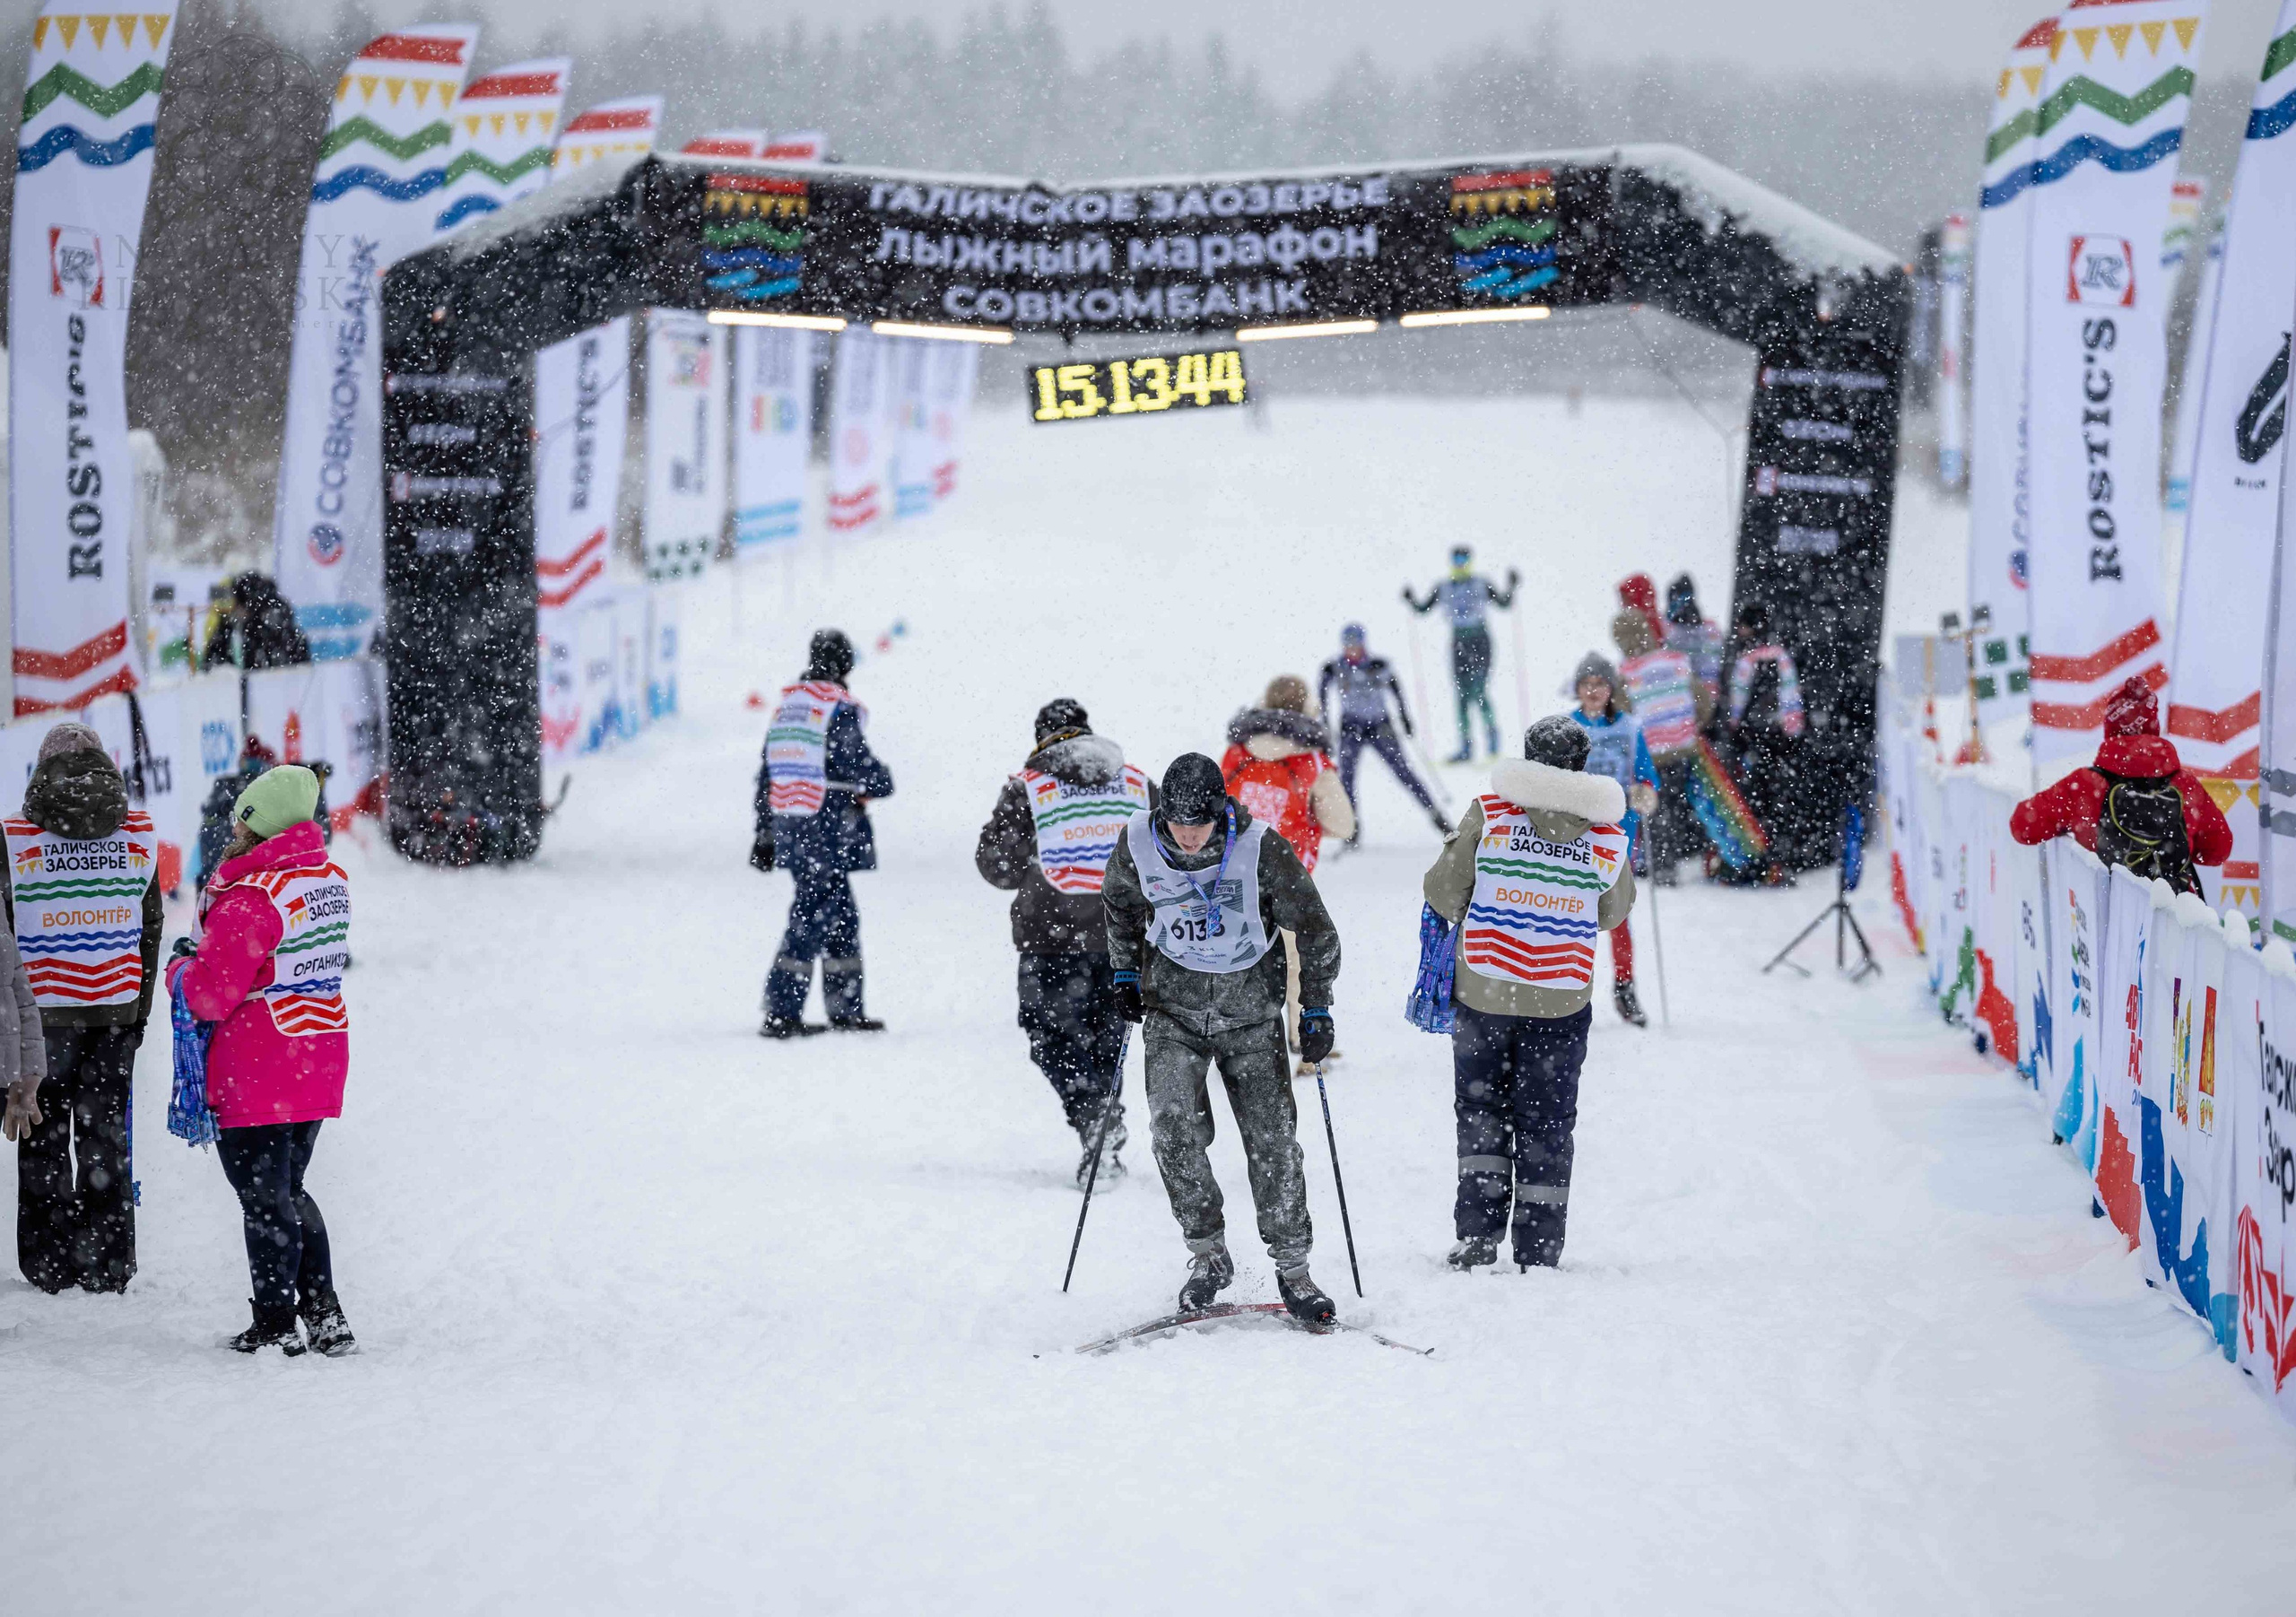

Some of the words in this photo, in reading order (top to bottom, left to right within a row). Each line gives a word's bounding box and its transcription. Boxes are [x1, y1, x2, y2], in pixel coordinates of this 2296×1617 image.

[868, 183, 1138, 224] ГАЛИЧСКОЕ
[1147, 178, 1389, 222] ЗАОЗЕРЬЕ
[1126, 224, 1379, 276] марафон
[942, 280, 1310, 321] СОВКОМБАНК
[2082, 317, 2123, 584] ROSTIC'S
[1060, 784, 1126, 799] ЗАОЗЕРЬЕ
[1064, 822, 1126, 840] ВОЛОНТ
[44, 840, 126, 856] ГАЛИЧСКОЕ
[1510, 838, 1591, 865] ЗАОЗЕРЬЕ
[45, 856, 127, 873] ЗАОЗЕРЬЕ
[309, 899, 349, 922] ЗАОЗЕРЬЕ
[1496, 887, 1585, 914] ВОЛОНТЁР
[42, 906, 132, 928] ВОЛОНТЁР
